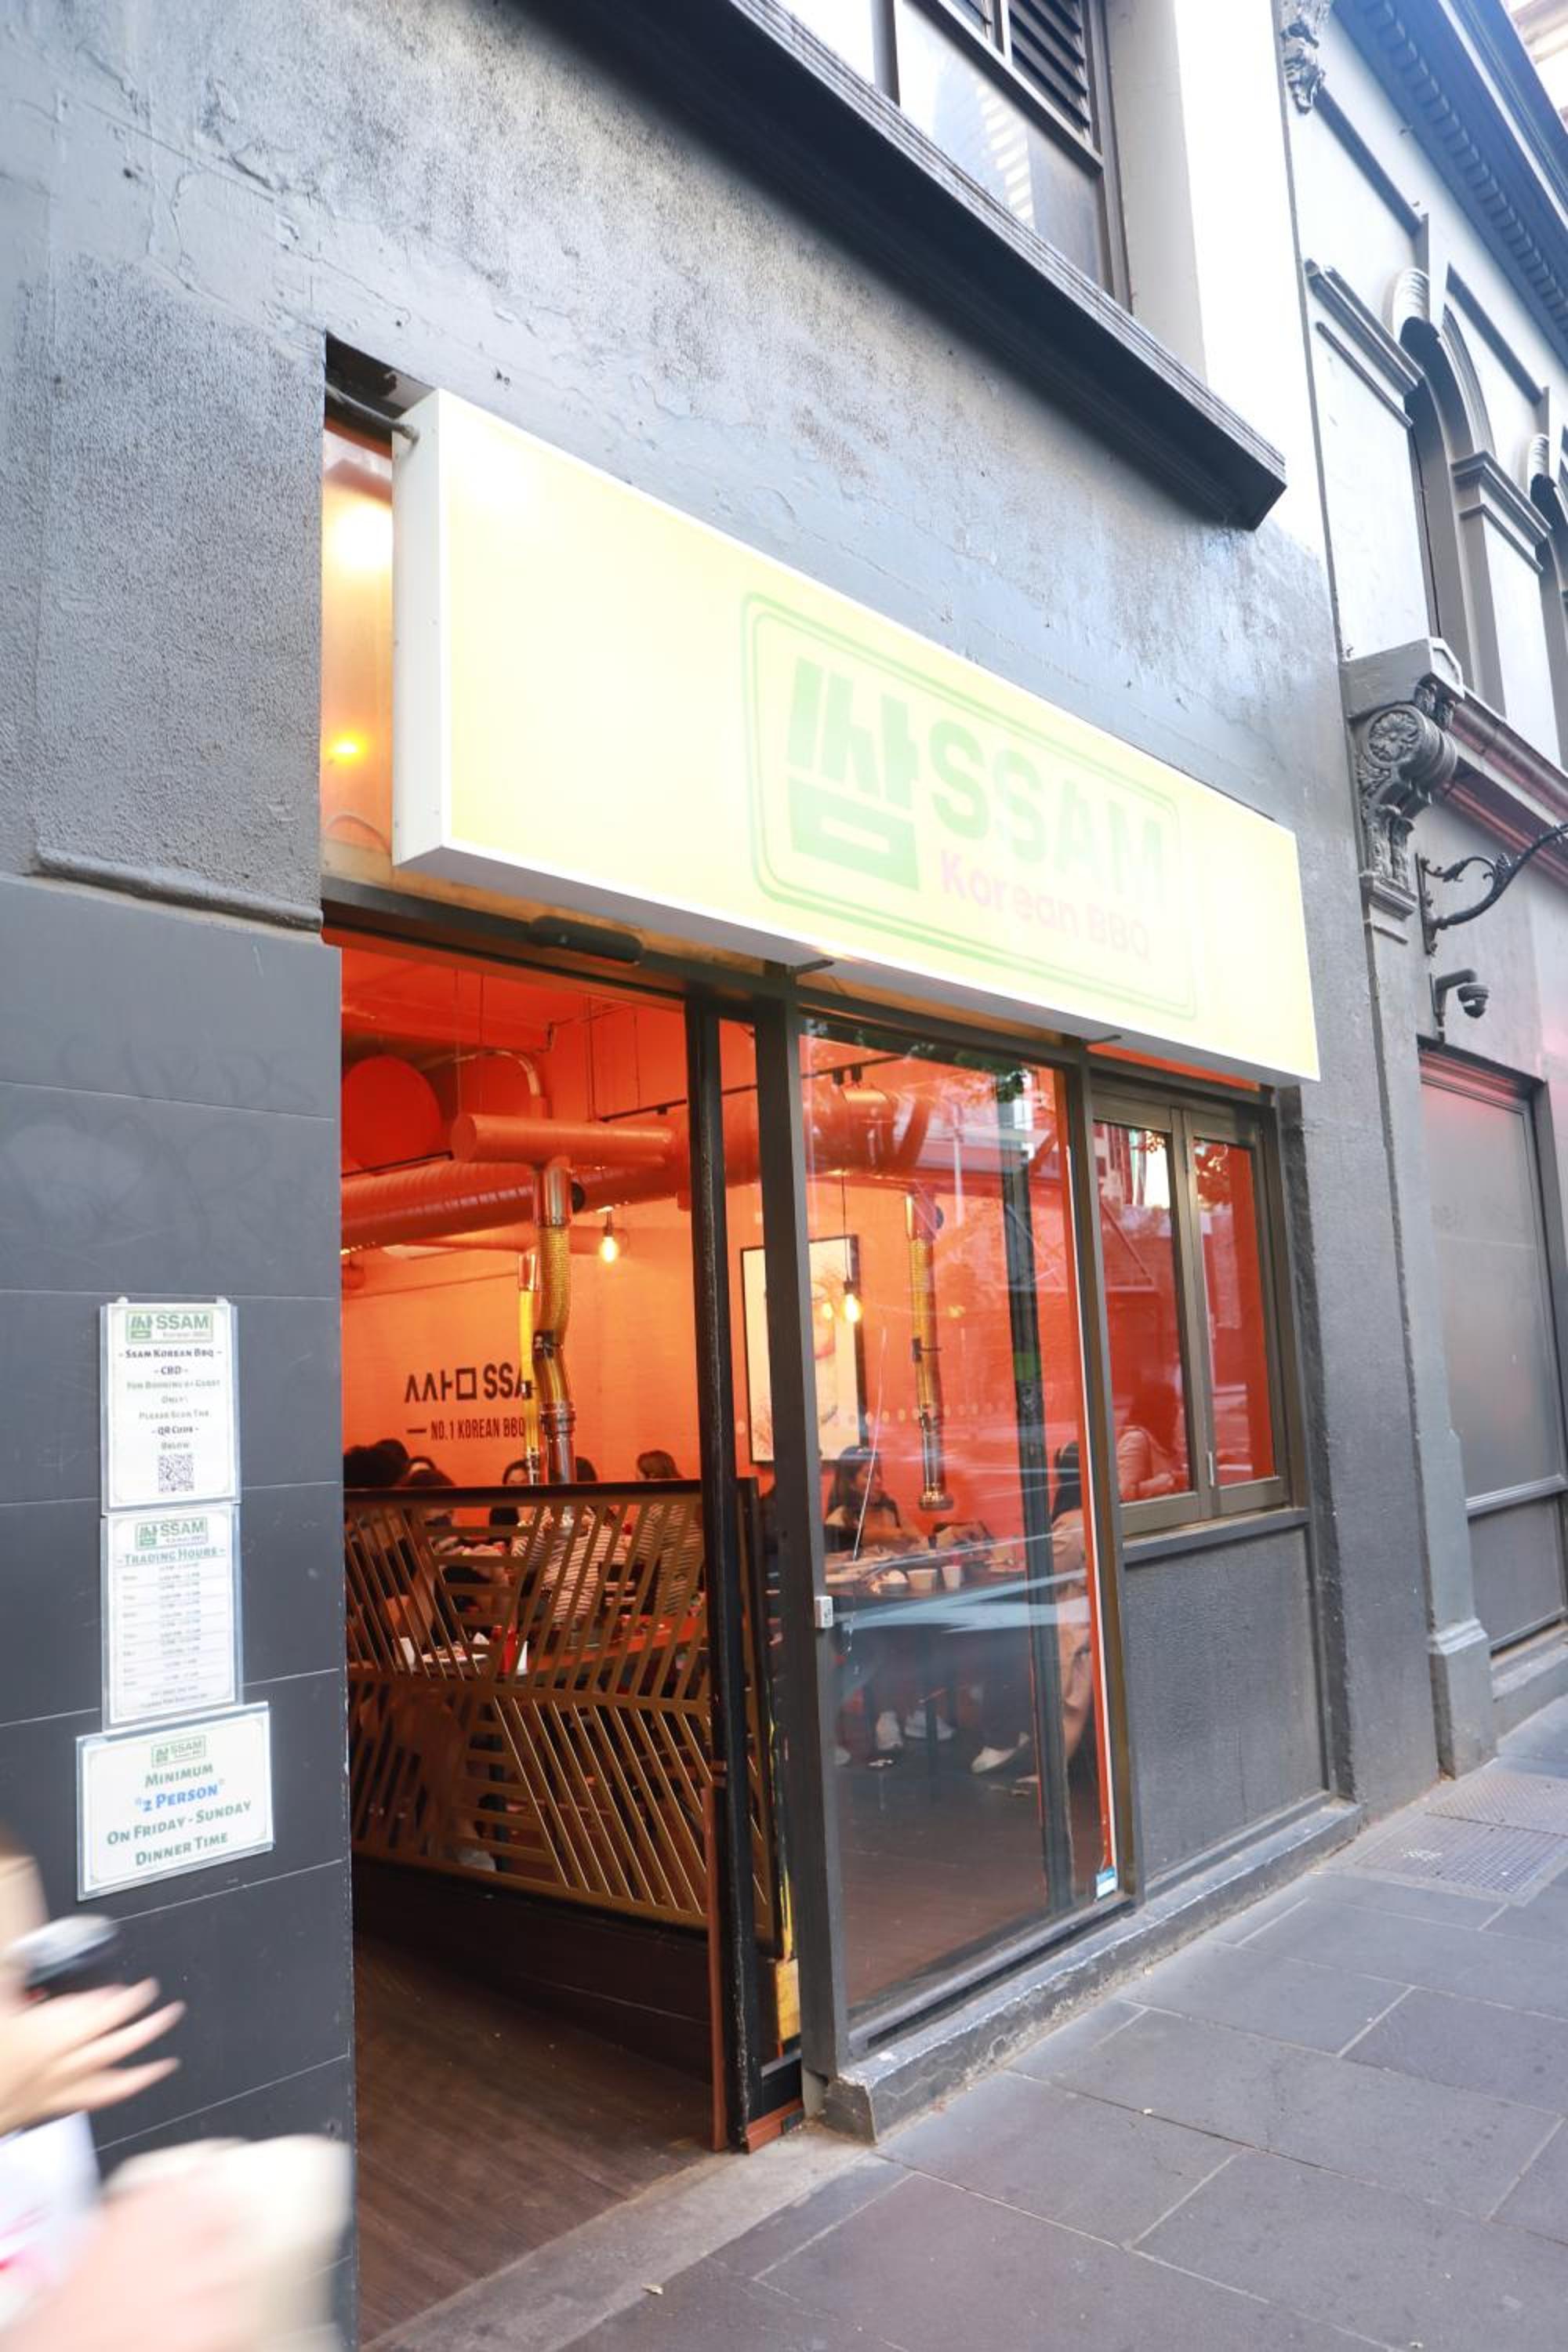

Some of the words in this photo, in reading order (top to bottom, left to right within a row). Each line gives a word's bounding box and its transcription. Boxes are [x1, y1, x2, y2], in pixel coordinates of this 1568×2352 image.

[786, 655, 920, 891] 쌈
[928, 718, 1165, 906] SSAM
[940, 848, 1081, 937] Korean
[1087, 902, 1152, 966] BBQ
[156, 1314, 209, 1330] SSAM
[457, 1417, 499, 1439] KOREAN
[159, 1520, 204, 1537] SSAM
[171, 1739, 202, 1755] SSAM
